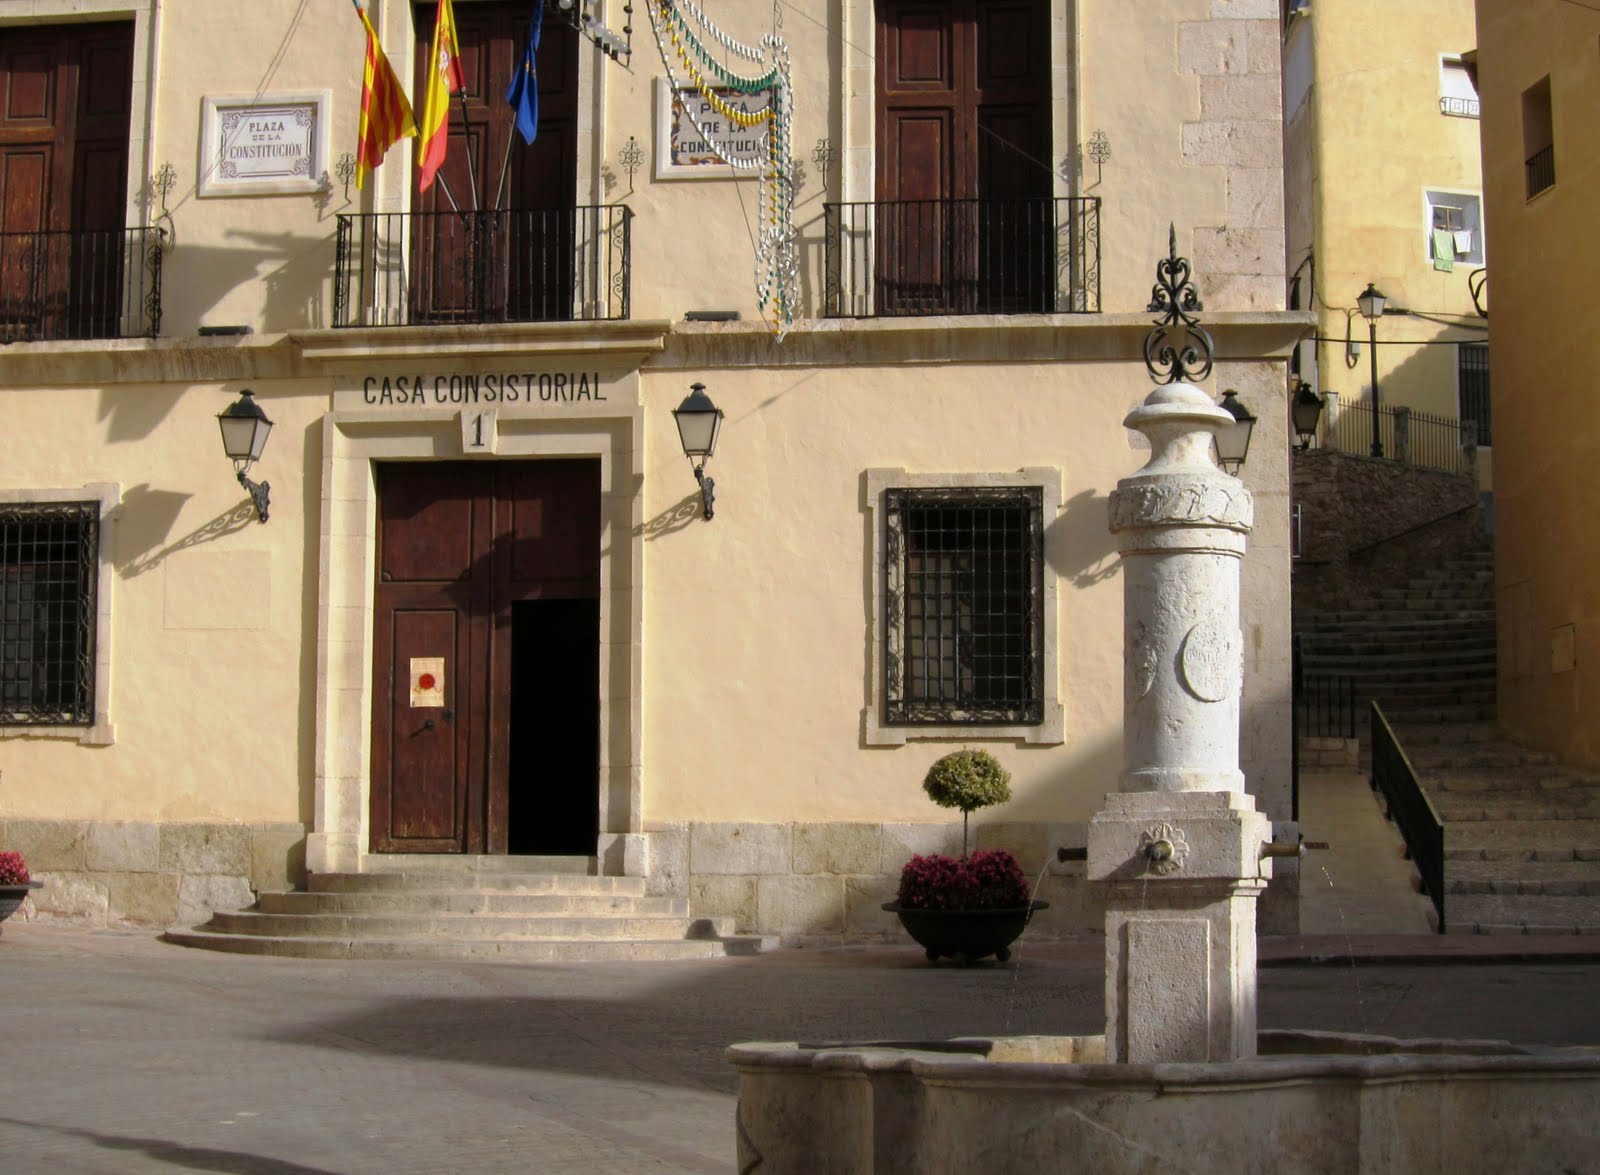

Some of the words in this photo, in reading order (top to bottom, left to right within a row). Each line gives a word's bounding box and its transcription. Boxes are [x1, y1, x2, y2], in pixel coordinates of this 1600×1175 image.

[250, 122, 284, 132] PLAZA
[268, 133, 281, 141] LA
[231, 143, 302, 159] CONSTITUCIÓN
[363, 376, 426, 405] CASA
[434, 372, 607, 403] CONSISTORIAL
[470, 414, 485, 446] 1
